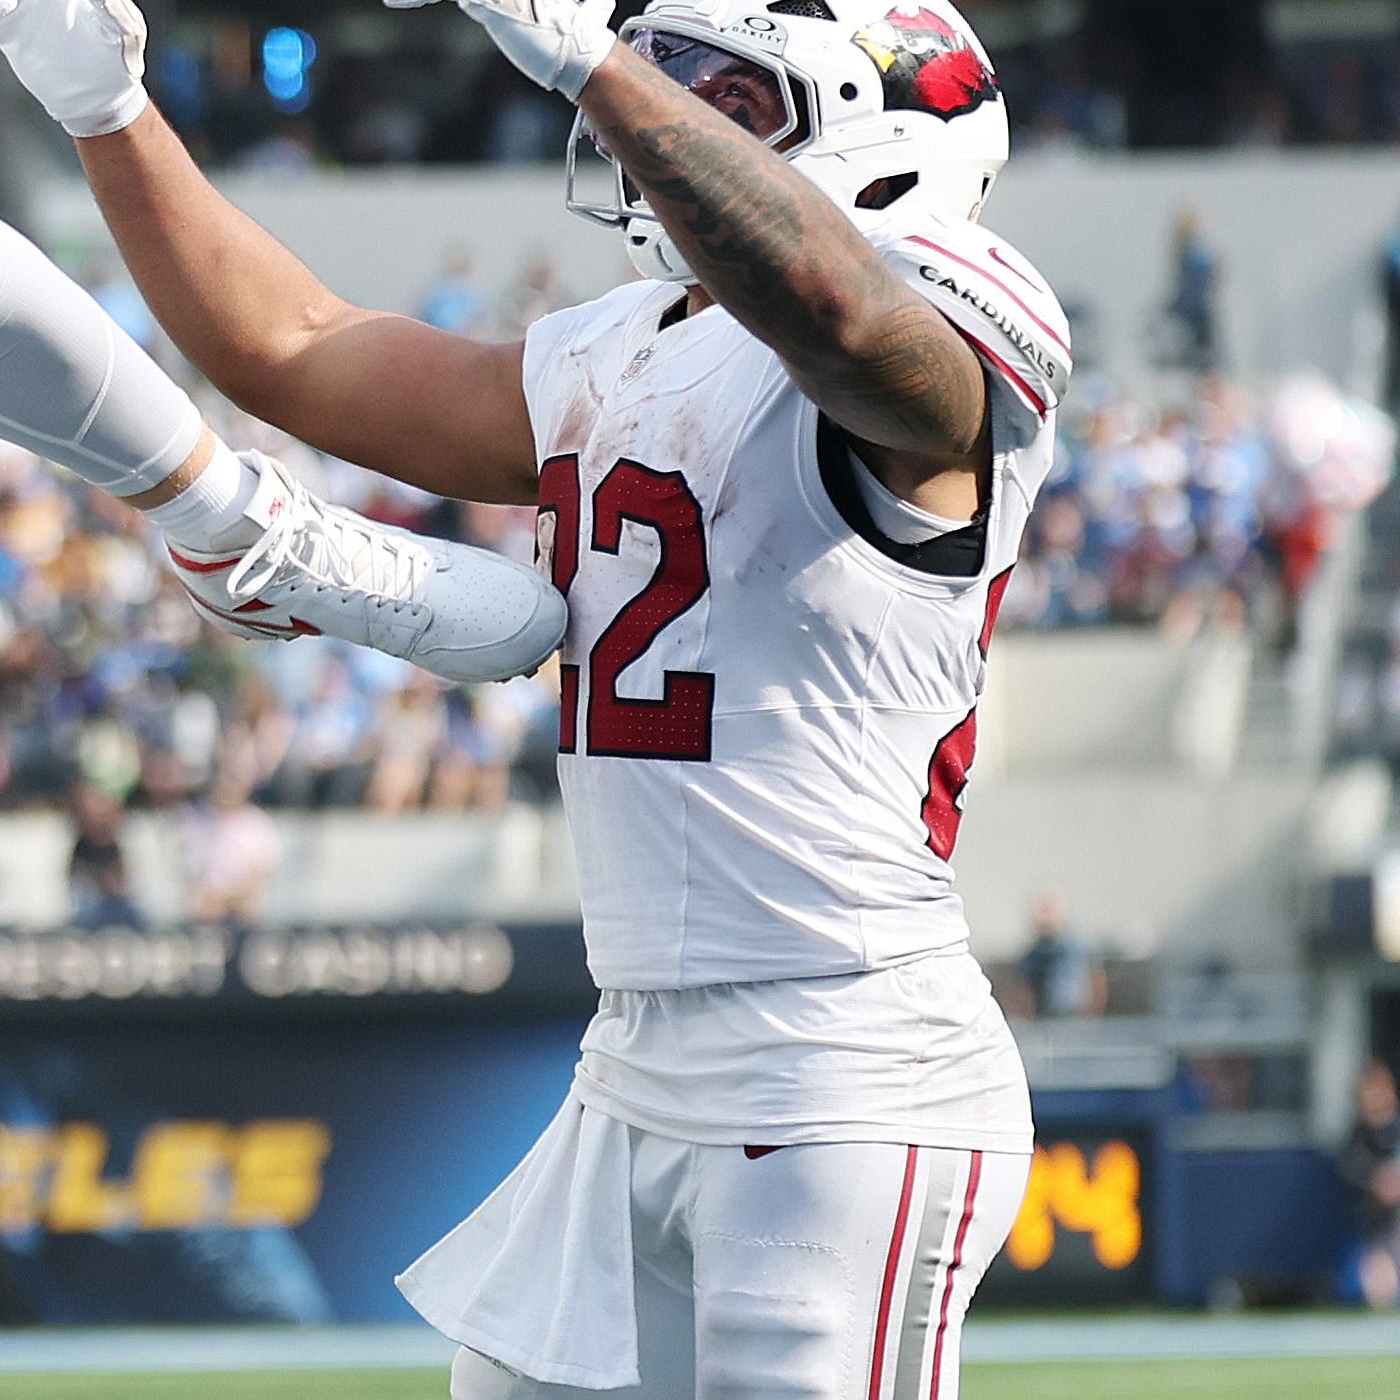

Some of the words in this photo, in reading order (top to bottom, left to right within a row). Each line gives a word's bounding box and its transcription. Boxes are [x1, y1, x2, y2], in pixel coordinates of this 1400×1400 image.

[732, 26, 783, 44] OAKLEY
[919, 264, 1056, 379] CARDINALS
[239, 922, 514, 998] CASINO
